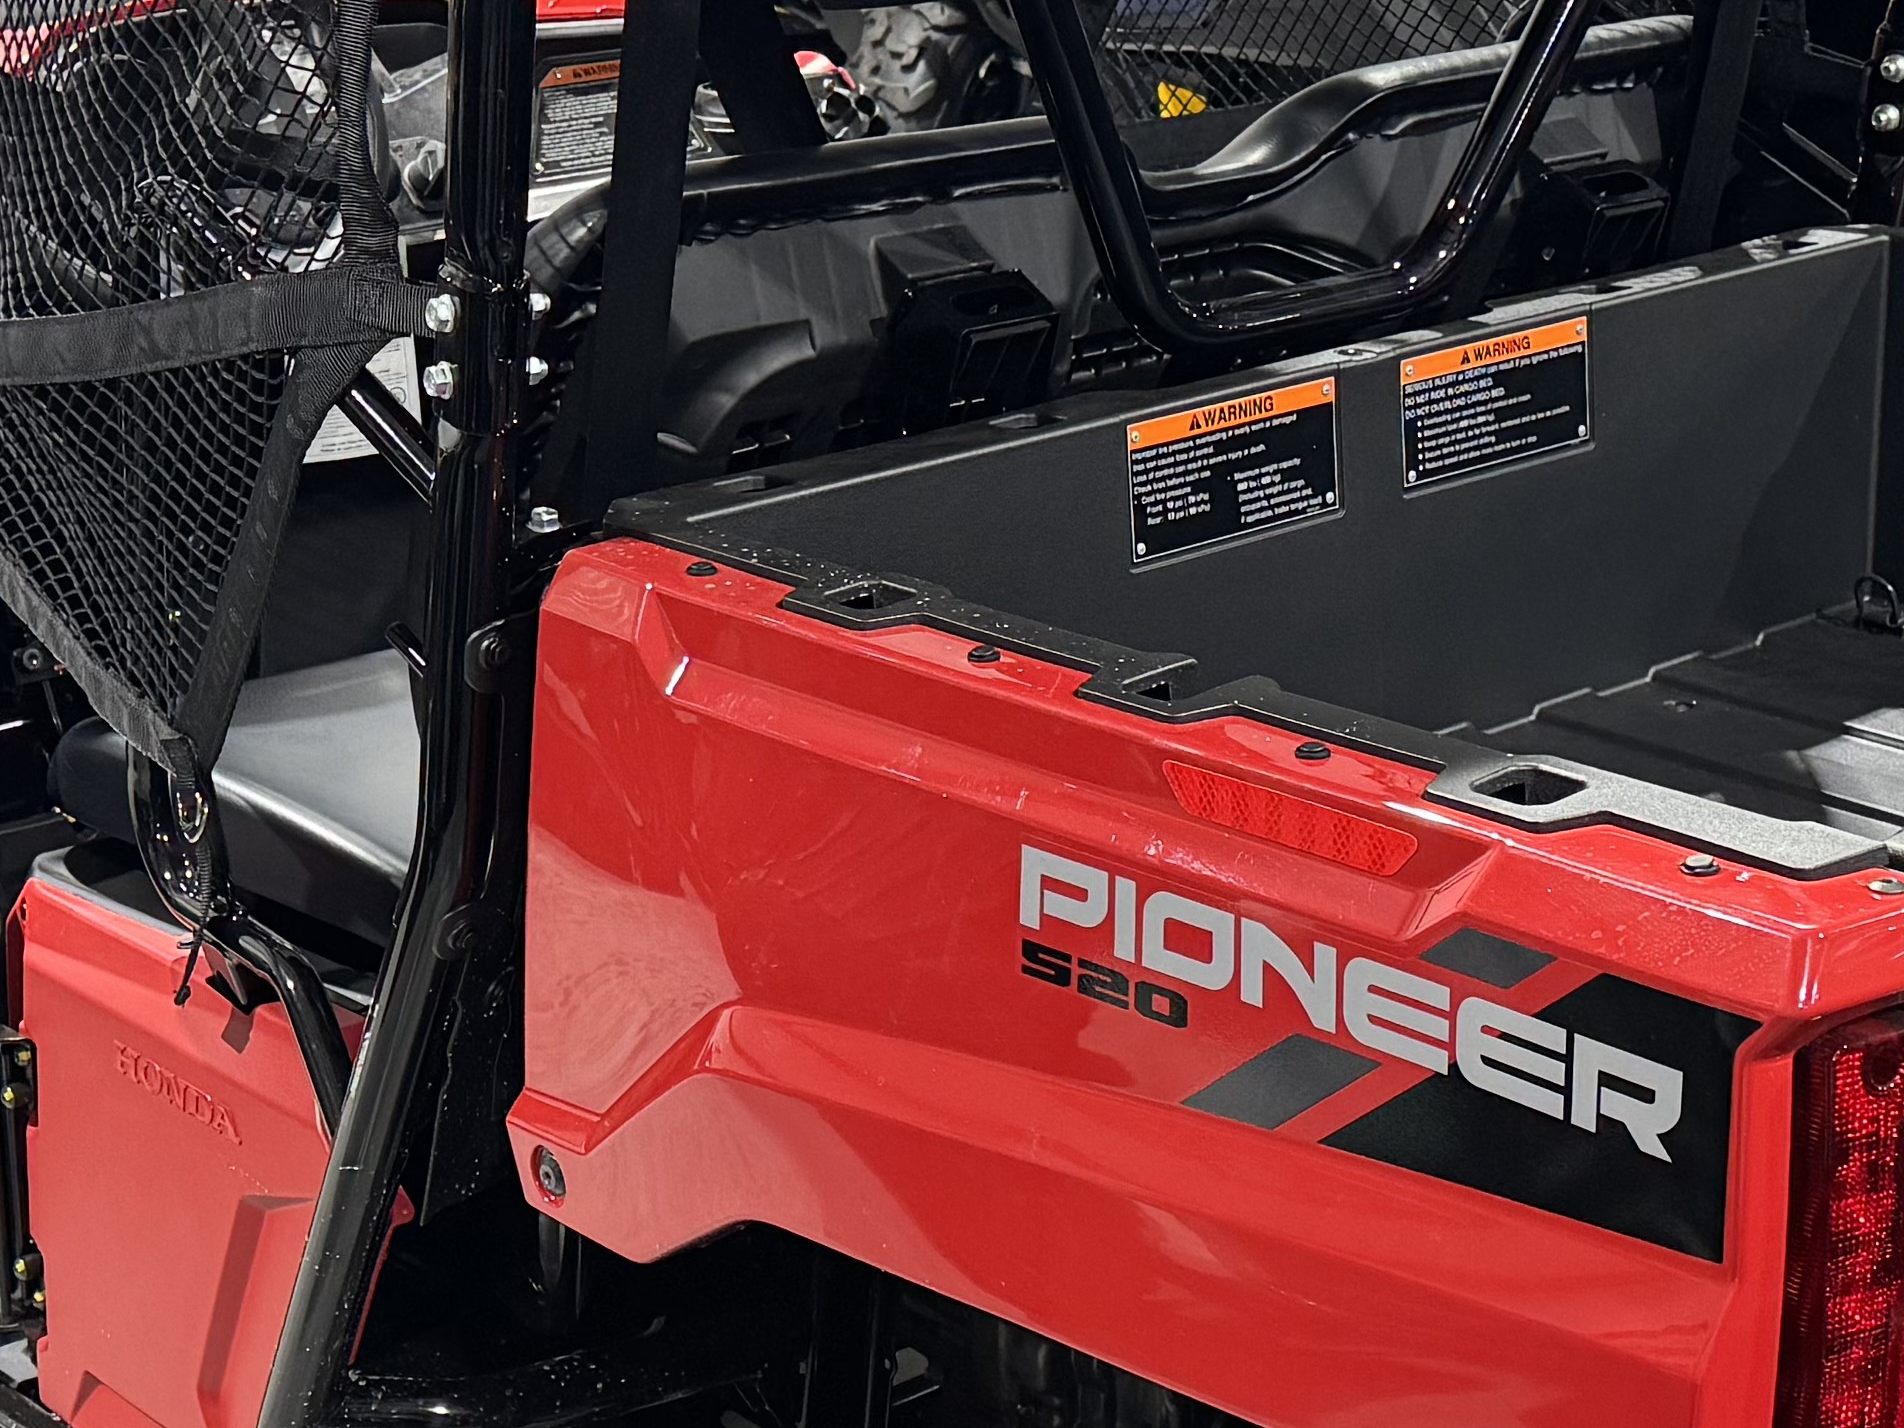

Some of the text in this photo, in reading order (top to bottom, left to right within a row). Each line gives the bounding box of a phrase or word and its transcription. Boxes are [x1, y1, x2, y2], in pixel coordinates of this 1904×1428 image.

[1474, 335, 1531, 362] WARNING
[1201, 396, 1274, 428] WARNING
[1019, 844, 1684, 1164] PIONEER
[1020, 938, 1189, 1029] 520
[113, 1039, 244, 1146] HONDA
